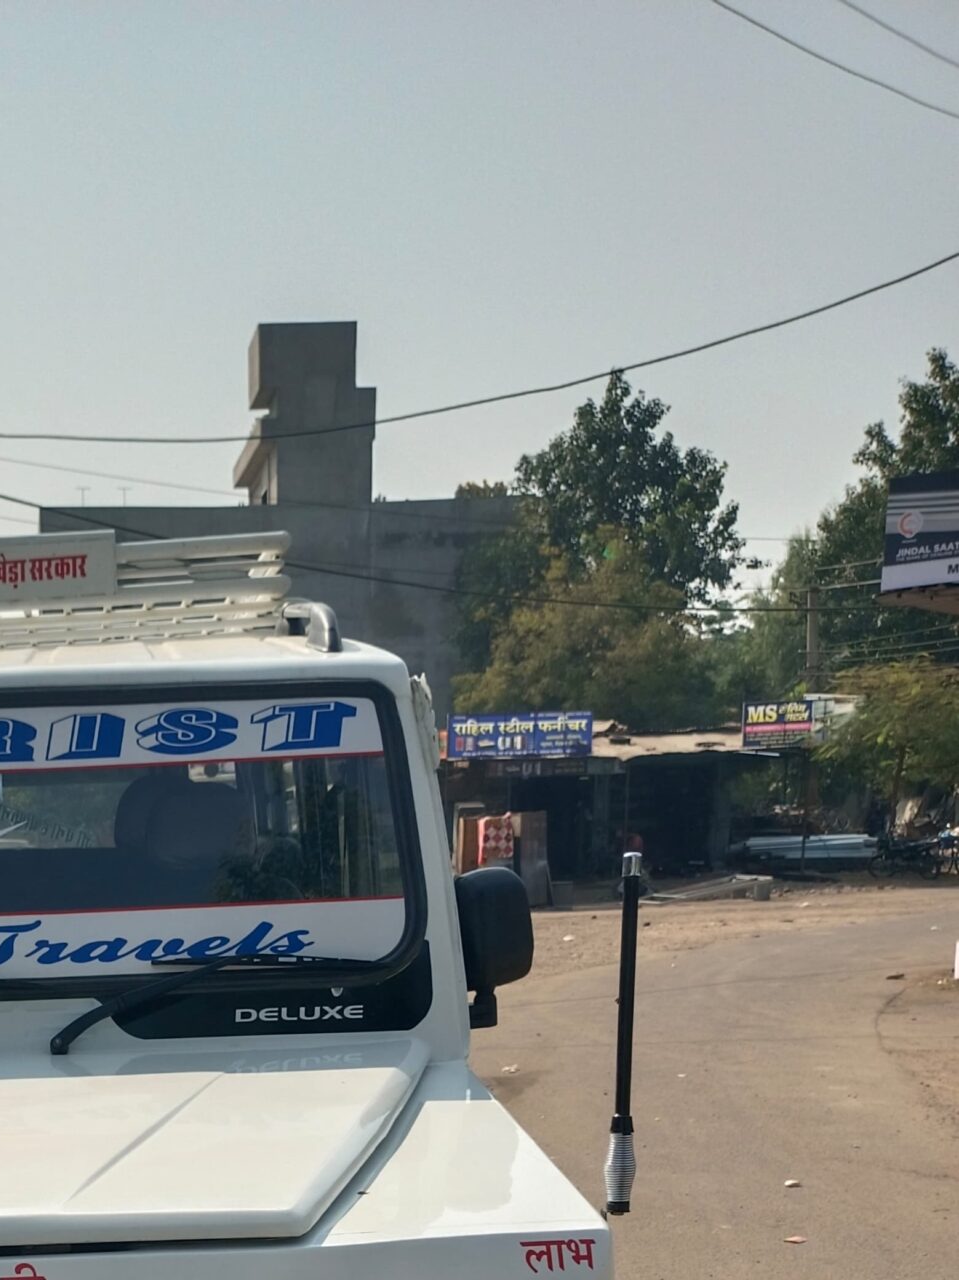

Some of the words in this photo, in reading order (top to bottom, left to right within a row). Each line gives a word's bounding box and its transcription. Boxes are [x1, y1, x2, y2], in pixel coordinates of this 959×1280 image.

[896, 545, 932, 558] JINDAL
[29, 554, 88, 581] सरकार
[746, 703, 778, 724] MS
[453, 718, 495, 736] राहिल
[497, 717, 535, 734] स्टील
[235, 1005, 364, 1023] DELUXE
[519, 1239, 596, 1273] लाभ
